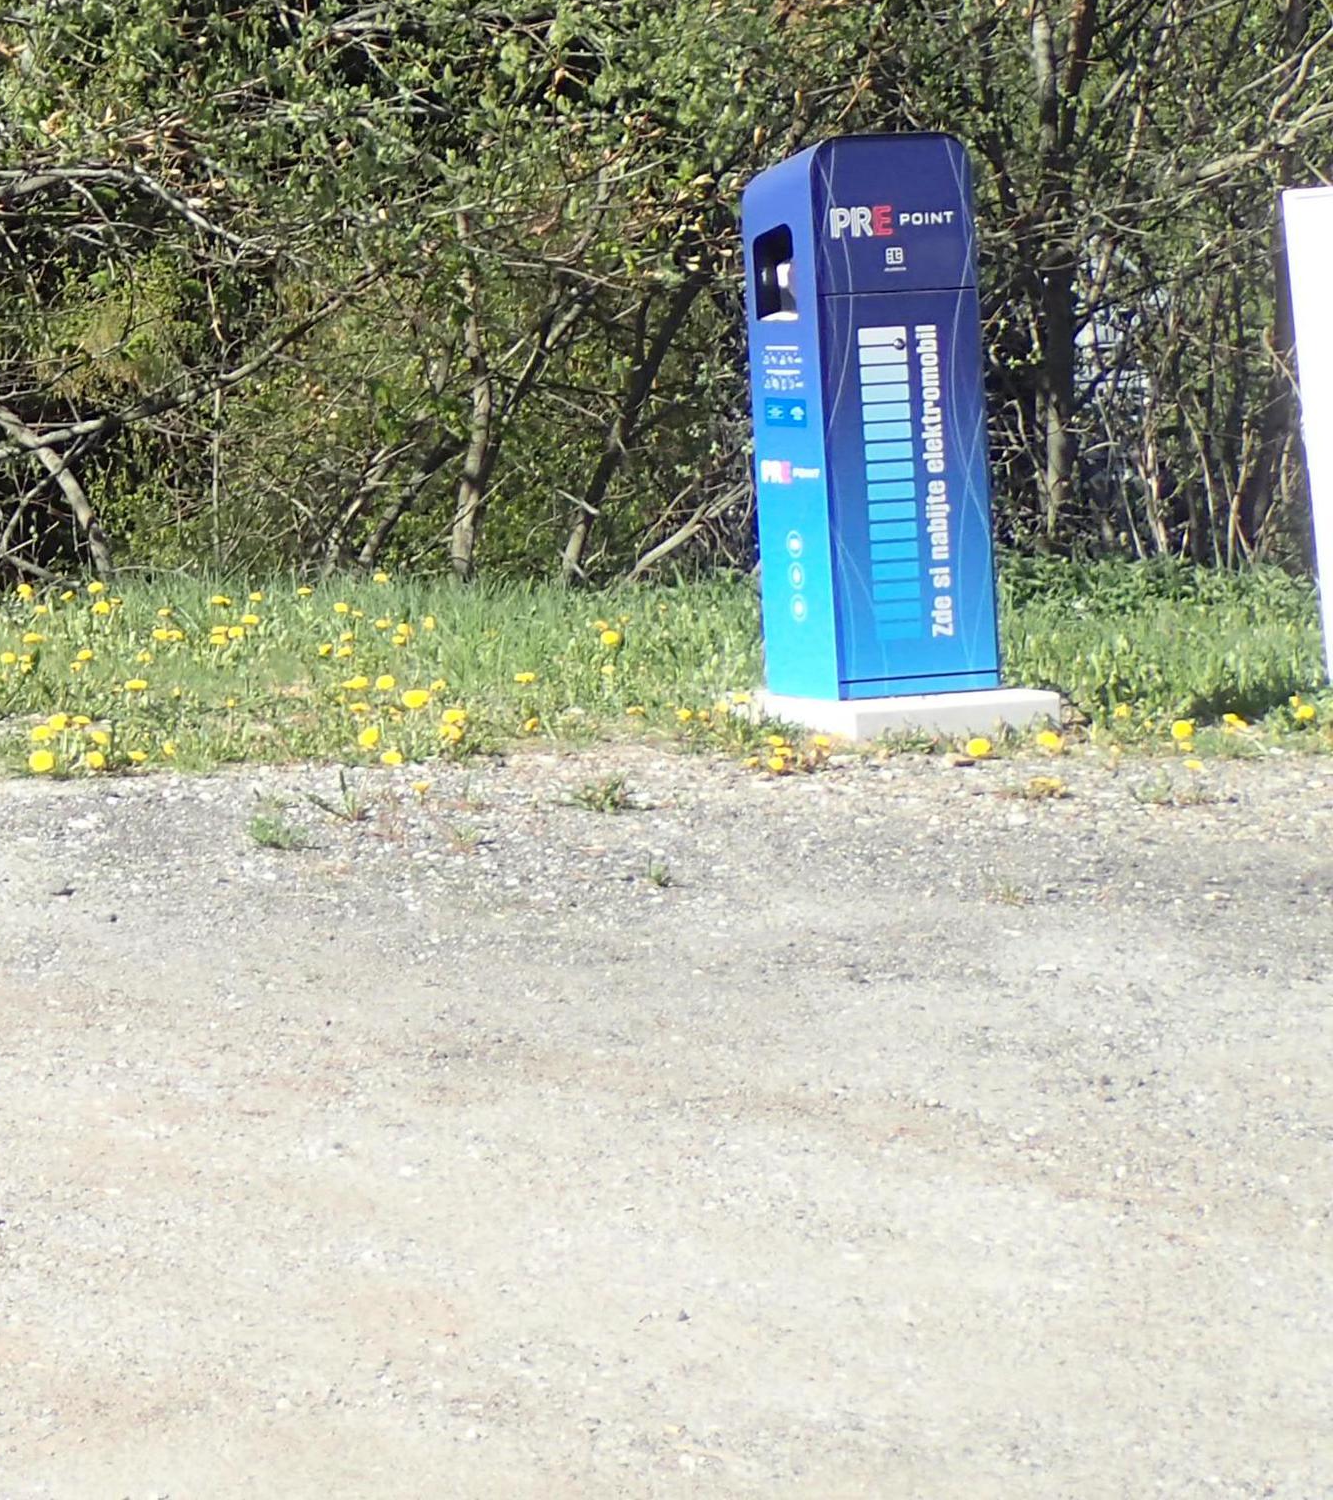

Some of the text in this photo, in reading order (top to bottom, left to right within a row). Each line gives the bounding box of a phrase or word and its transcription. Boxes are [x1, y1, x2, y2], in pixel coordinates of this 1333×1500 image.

[829, 205, 955, 239] PRE POINT
[914, 324, 954, 638] Zde si nabijte elektromobil
